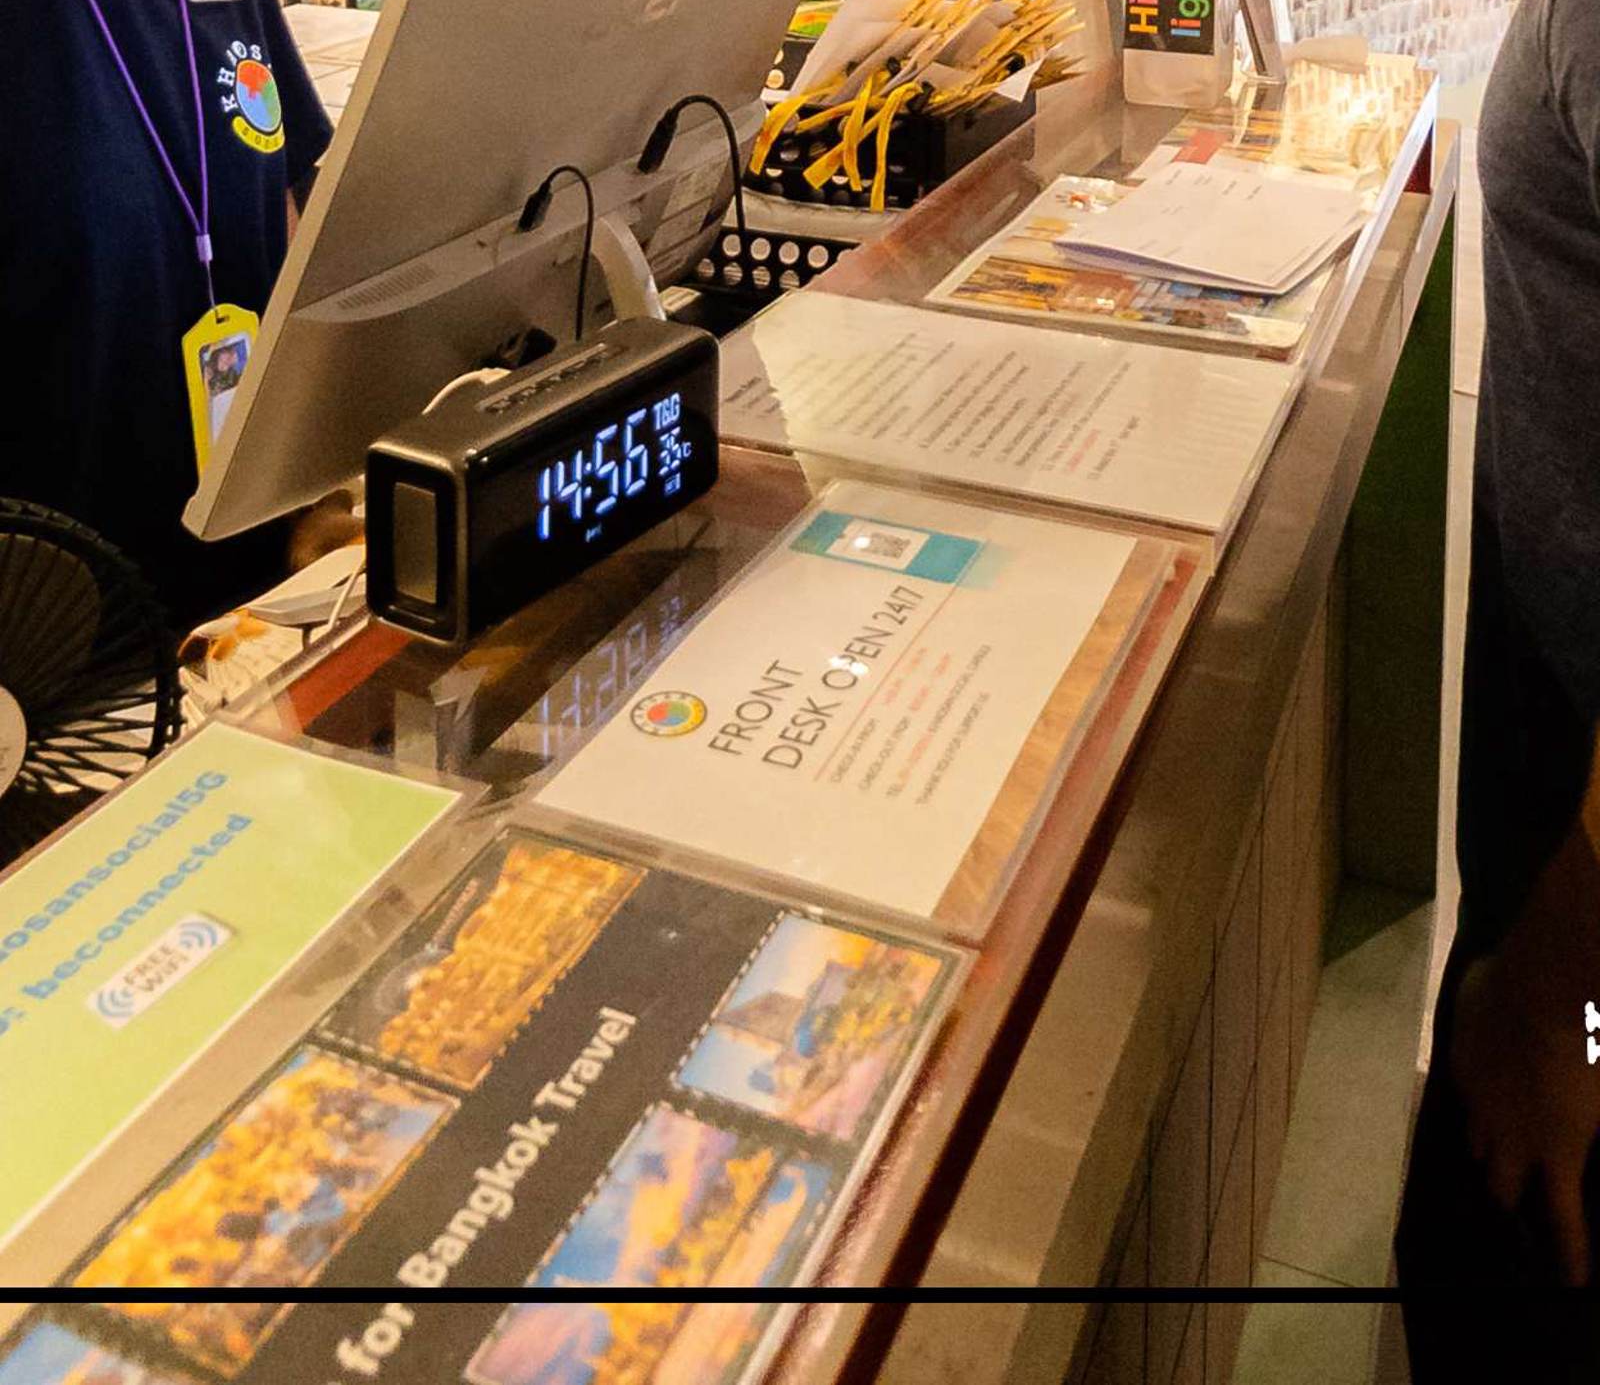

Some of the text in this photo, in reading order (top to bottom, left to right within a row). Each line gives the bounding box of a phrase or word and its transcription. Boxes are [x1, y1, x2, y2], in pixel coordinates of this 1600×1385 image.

[538, 408, 648, 541] 14:56
[708, 660, 803, 755] FRONT
[762, 697, 842, 770] DESK
[872, 585, 924, 625] 24/7
[22, 813, 252, 999] beconnected
[123, 943, 173, 986] FREE
[337, 1006, 638, 1376] for Bangkok Travel
